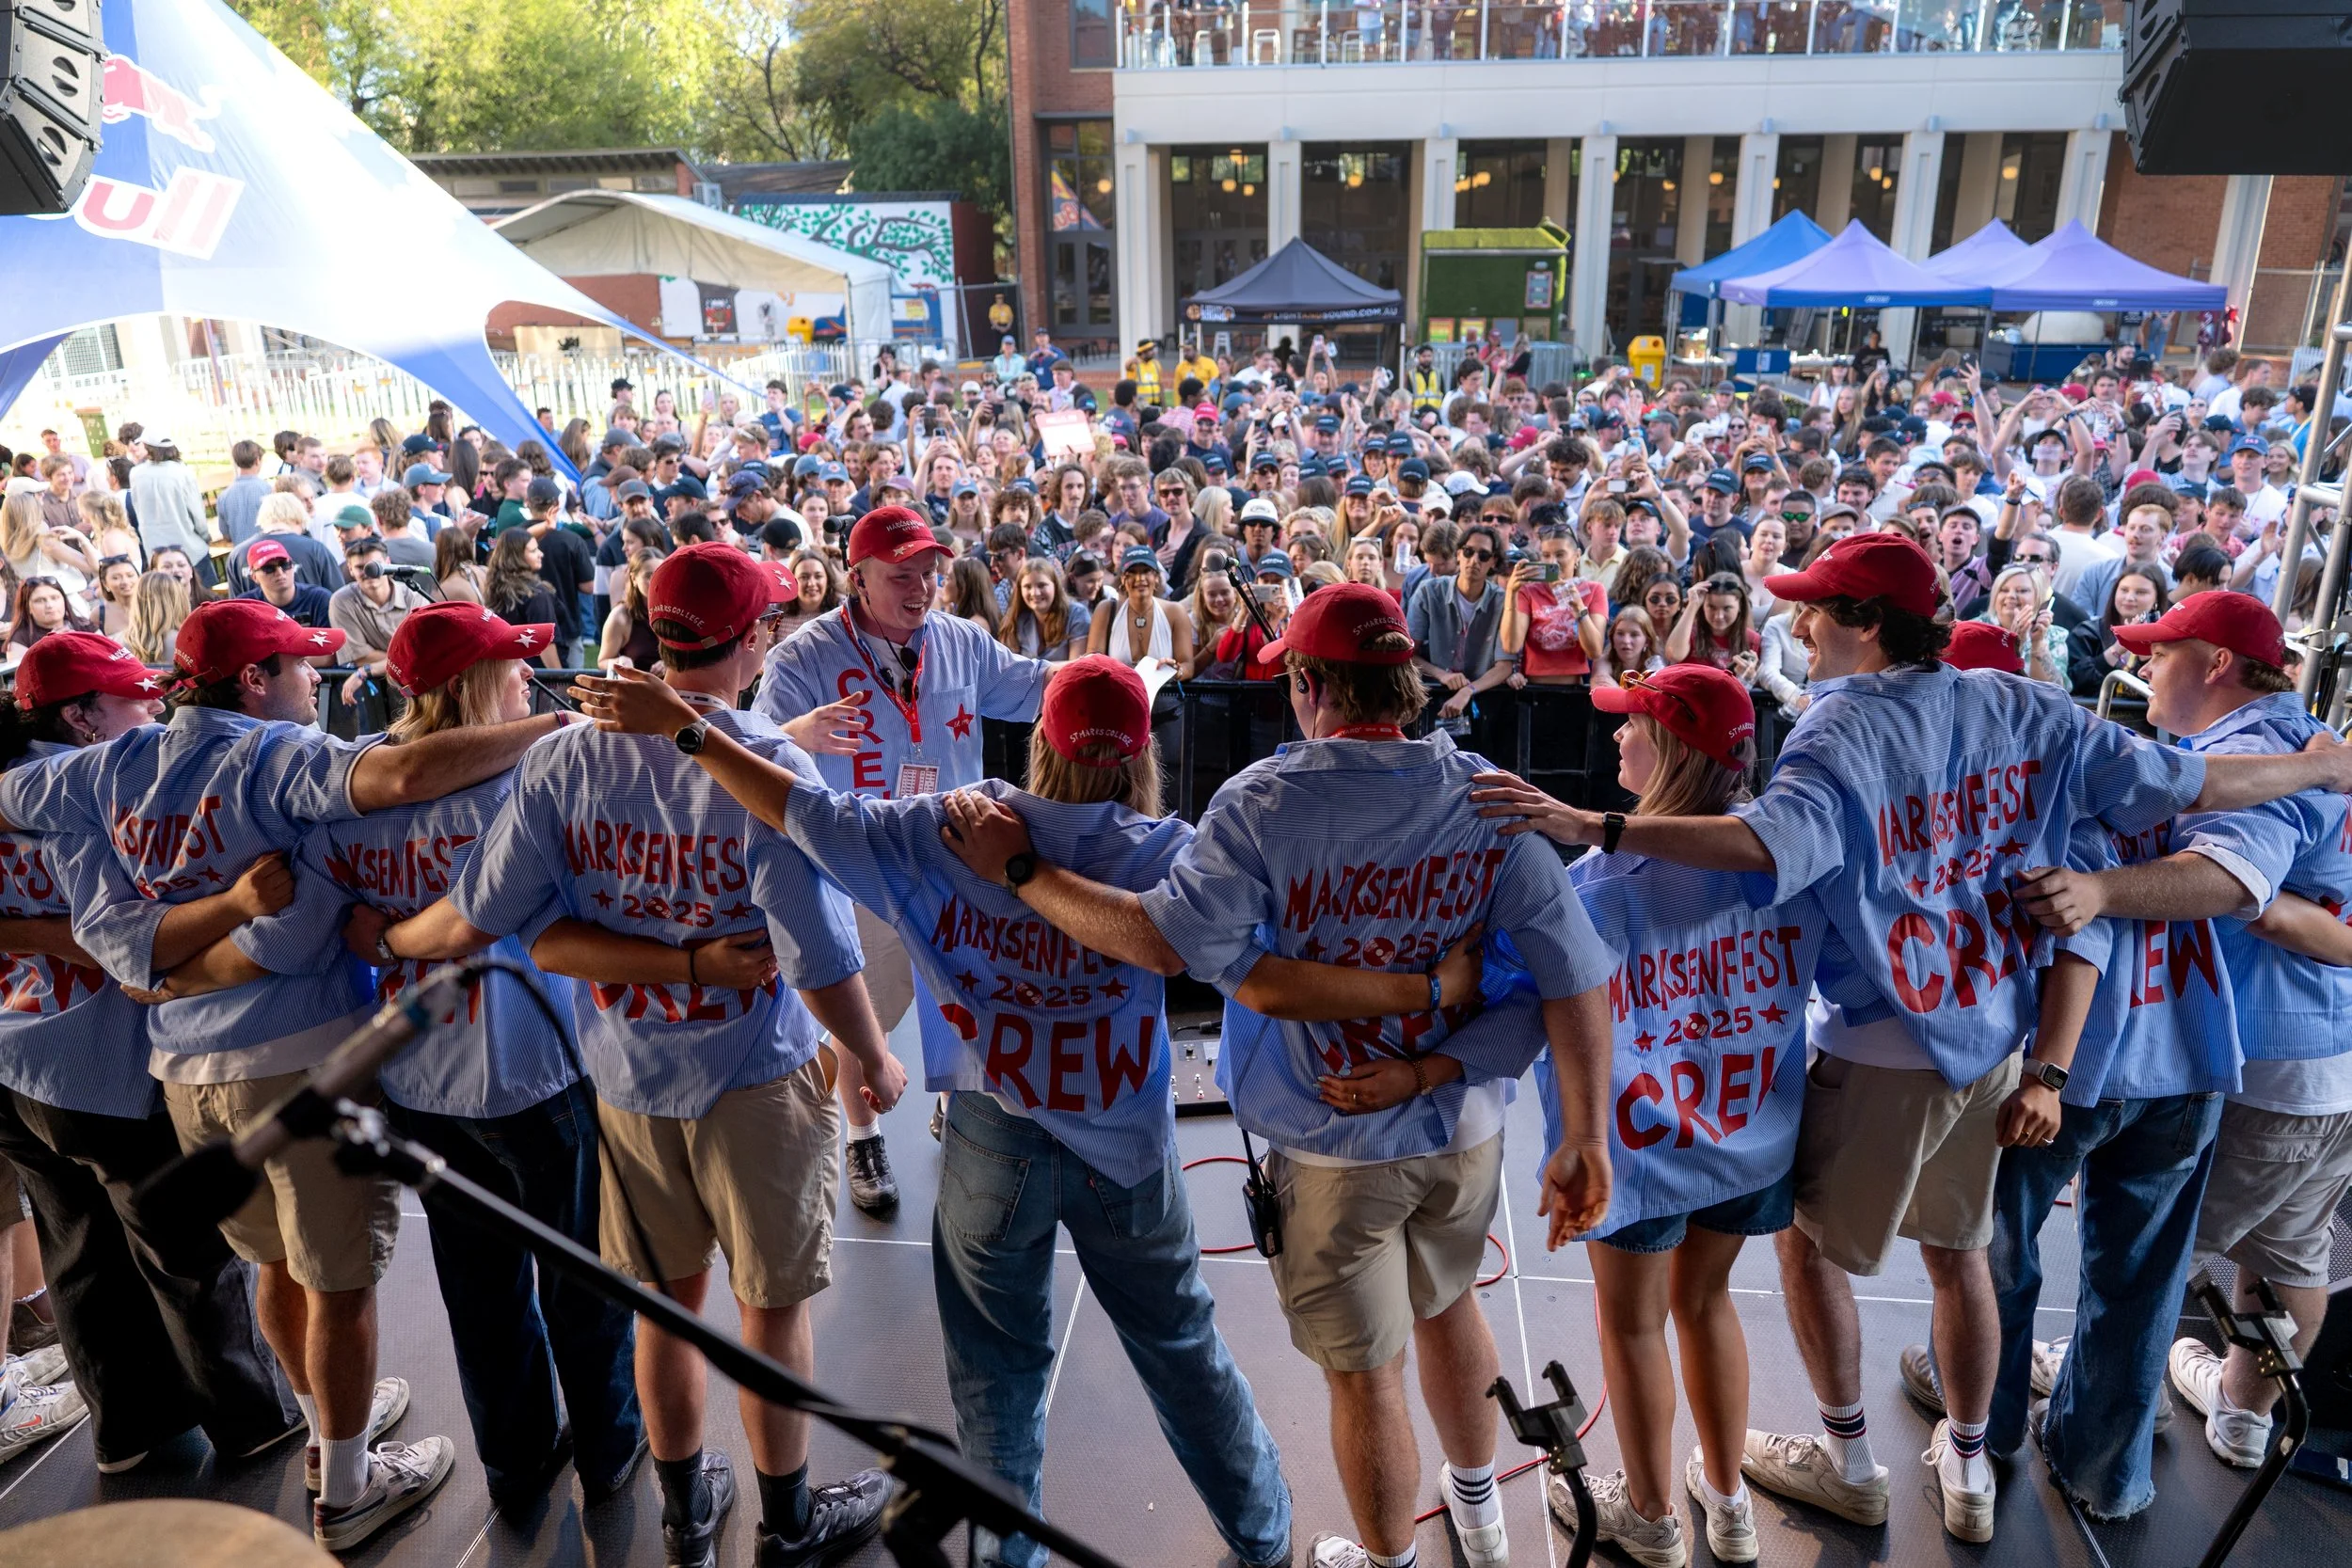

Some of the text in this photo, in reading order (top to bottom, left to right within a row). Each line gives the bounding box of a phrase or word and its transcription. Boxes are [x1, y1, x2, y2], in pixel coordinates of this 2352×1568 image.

[83, 175, 233, 250] ull
[1885, 662, 1914, 673] ANYARD
[837, 669, 891, 799] CRE
[1070, 732, 1079, 744] ST
[1079, 727, 1104, 739] MARKS
[565, 819, 747, 896] ARKSENFES
[622, 893, 715, 929] 2025
[930, 895, 1122, 980] MARKSENF
[1334, 930, 1439, 968] 2025
[991, 974, 1091, 1008] 2025
[1608, 926, 1802, 1023] MARKSENFEST
[1662, 1006, 1755, 1047] 2025
